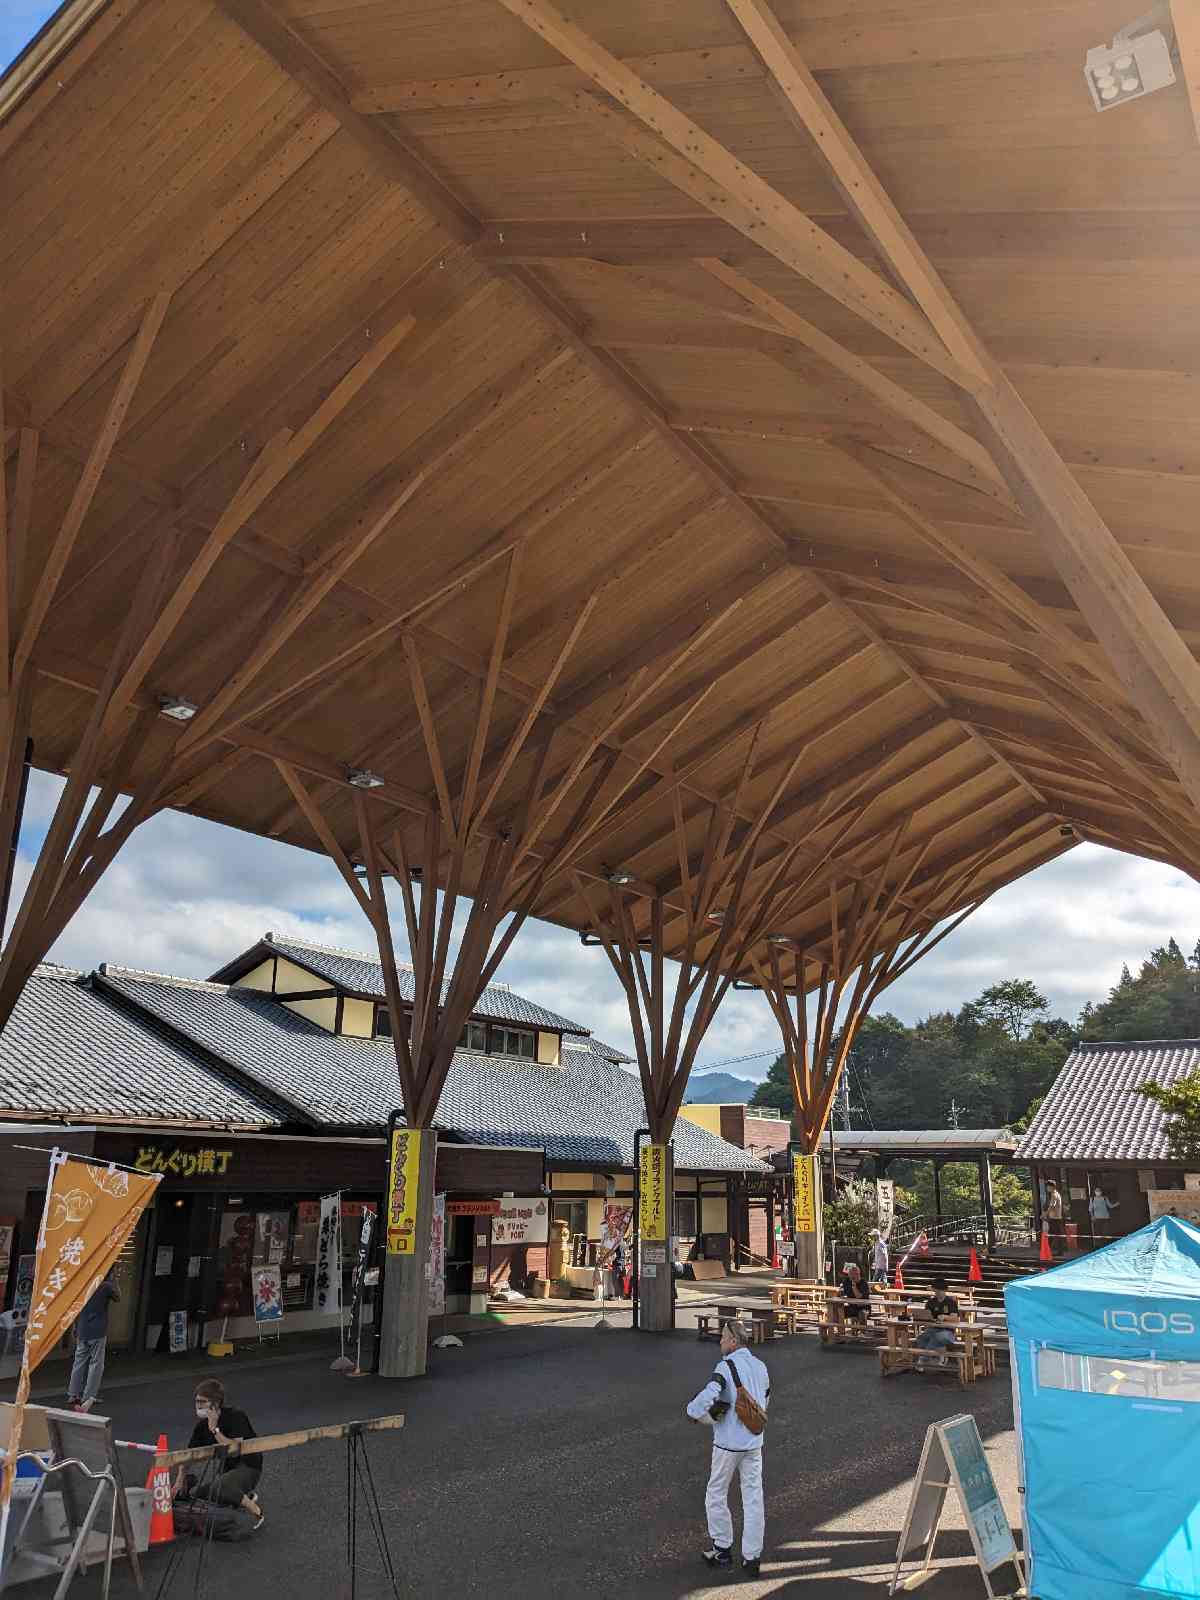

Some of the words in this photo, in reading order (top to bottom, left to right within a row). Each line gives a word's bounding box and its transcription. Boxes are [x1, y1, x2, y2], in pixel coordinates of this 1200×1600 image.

[135, 1146, 232, 1175] どんぐり横丁
[391, 1133, 410, 1223] どんぐり横丁
[1103, 1309, 1195, 1336] IQOS
